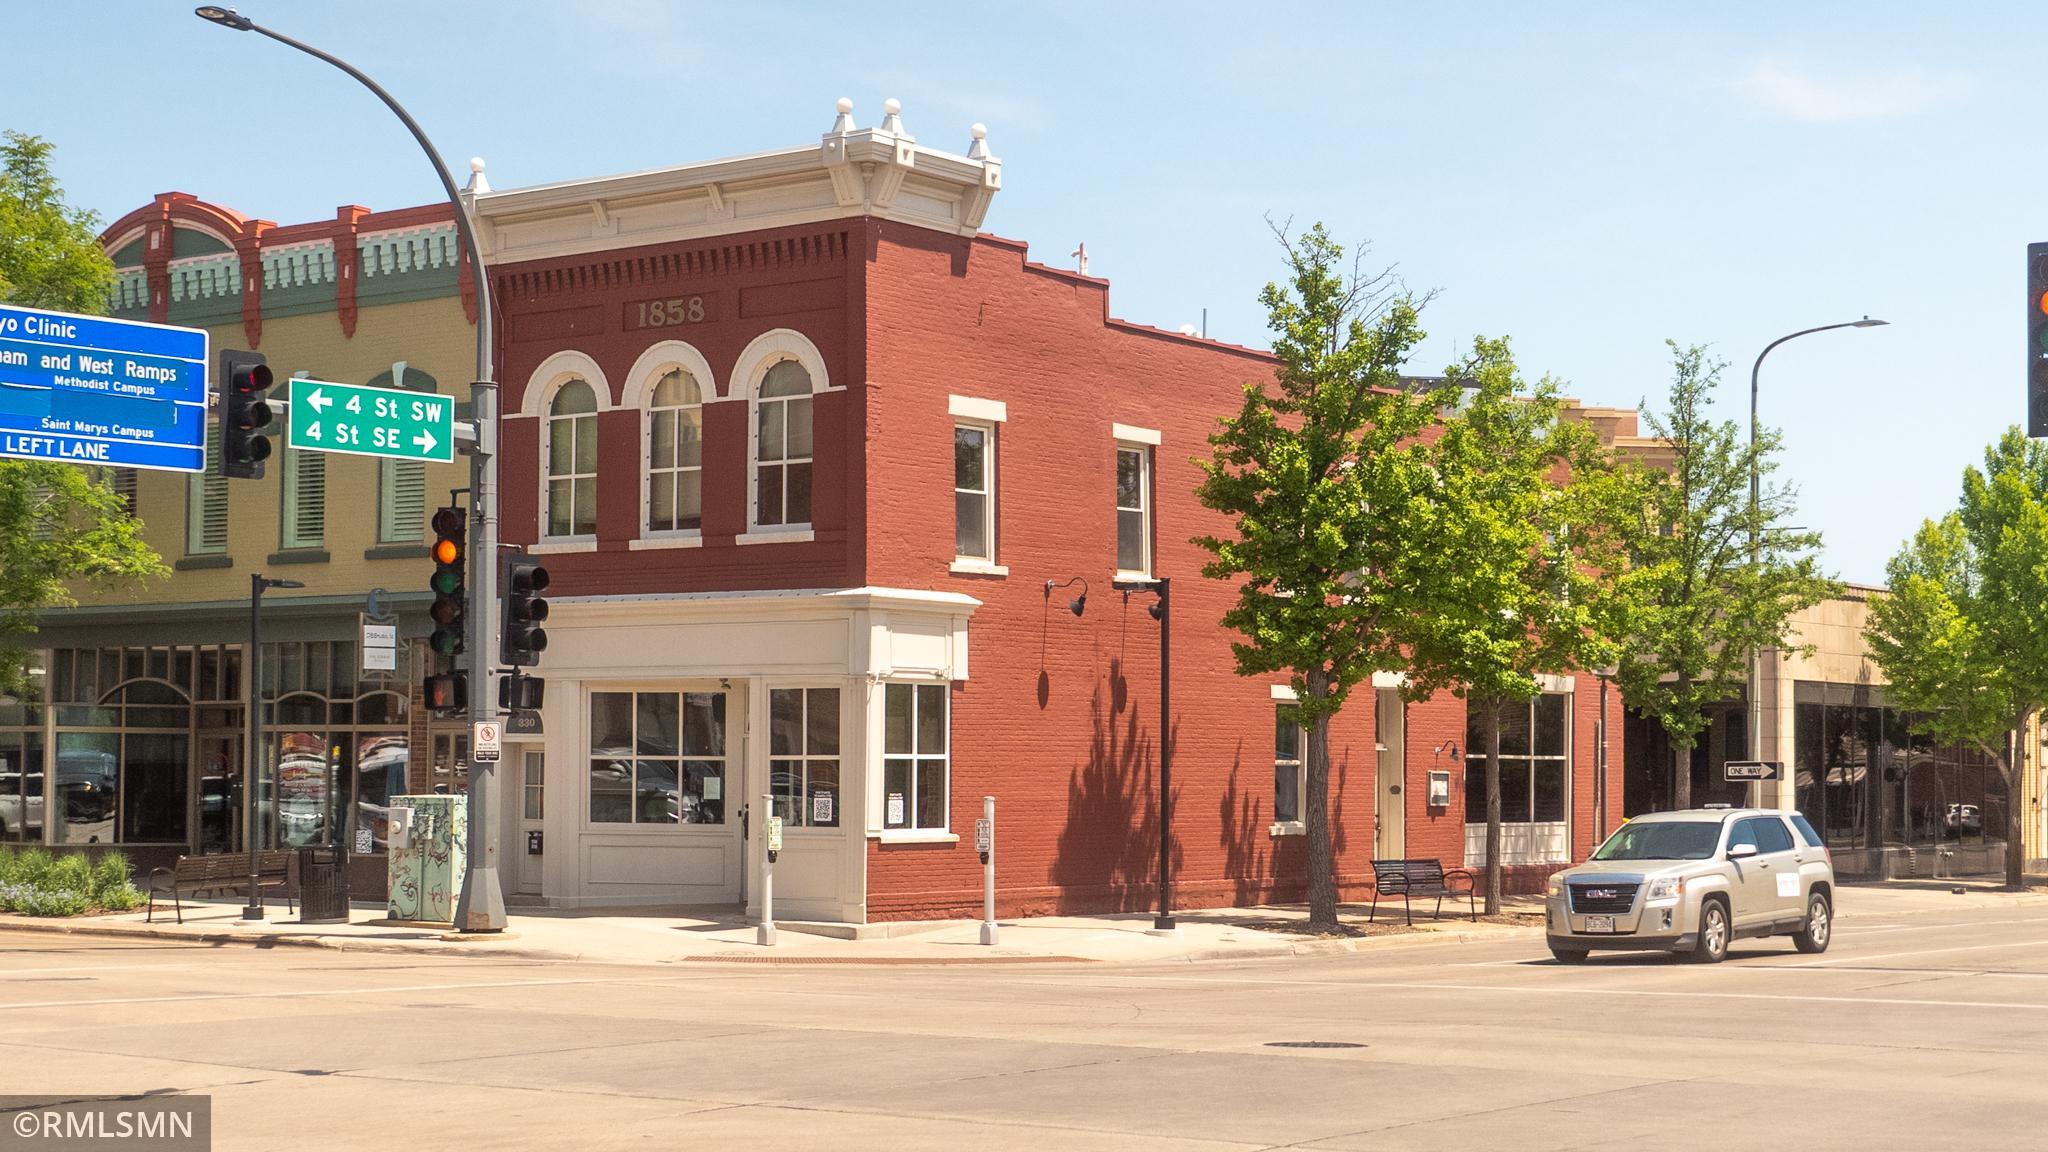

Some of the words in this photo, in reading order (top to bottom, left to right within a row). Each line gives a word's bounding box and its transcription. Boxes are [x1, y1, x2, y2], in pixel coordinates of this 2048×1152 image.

[638, 296, 705, 328] 1858
[25, 316, 77, 339] Clinic
[0, 350, 28, 367] am
[41, 354, 71, 371] and
[79, 355, 114, 375] West
[126, 360, 177, 384] Ramps
[54, 375, 109, 391] Methodist
[113, 381, 156, 396] Campus
[345, 395, 361, 414] 4
[374, 397, 398, 419] St
[411, 401, 442, 423] SW
[42, 417, 70, 431] Saint
[75, 421, 108, 436] Marys
[112, 424, 154, 439] Campus
[306, 421, 322, 441] 4
[335, 423, 359, 445] St
[372, 427, 400, 449] SE
[6, 435, 55, 455] LEFT
[59, 440, 110, 460] LANE
[1730, 767, 1744, 775] ONE
[1747, 767, 1761, 775] WAY
